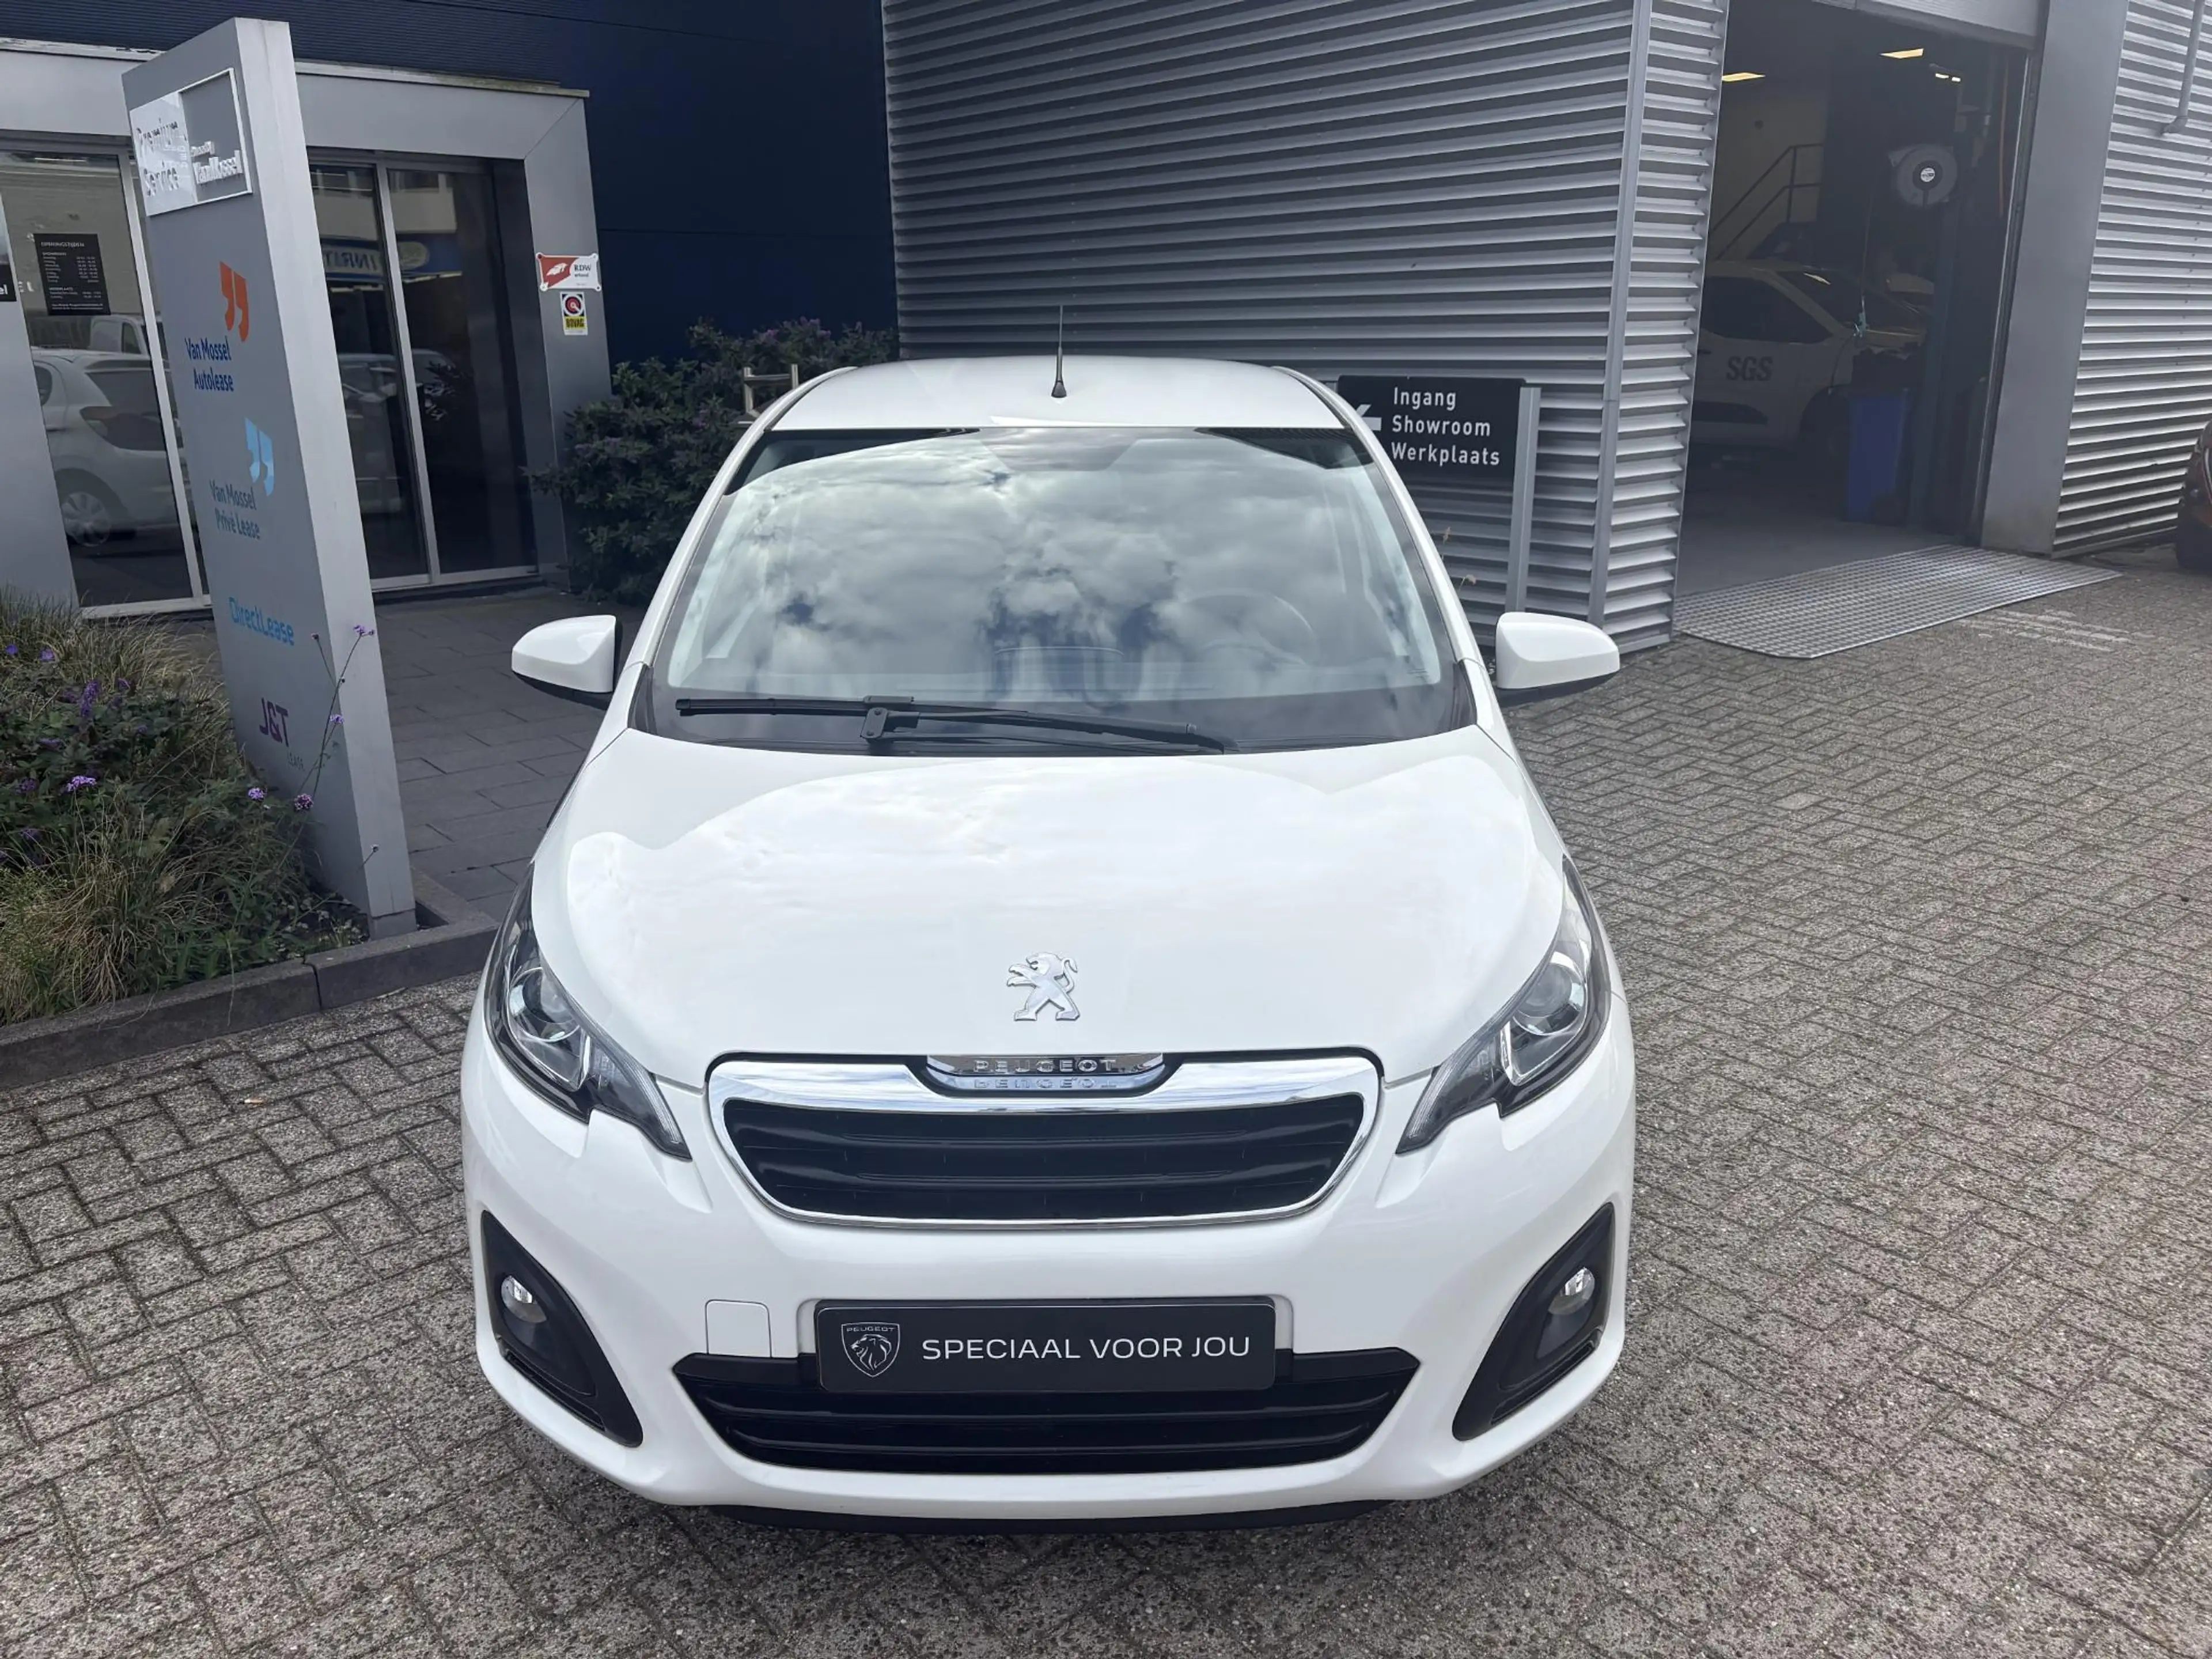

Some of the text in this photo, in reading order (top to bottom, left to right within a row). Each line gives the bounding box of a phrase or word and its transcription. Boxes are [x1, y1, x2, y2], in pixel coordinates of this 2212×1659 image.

[184, 335, 232, 361] Van Mossel
[194, 366, 234, 392] Autolease
[1726, 356, 1773, 381] SGS
[1393, 387, 1456, 411] Ingang
[1392, 415, 1491, 437] Showroom
[1391, 442, 1500, 467] Werkplaats
[209, 479, 257, 510] Van Mossel
[236, 516, 261, 540] Lease
[974, 1059, 1116, 1073] PEUGEOT
[922, 1336, 1250, 1360] SPECIAAL VOOR JOU
